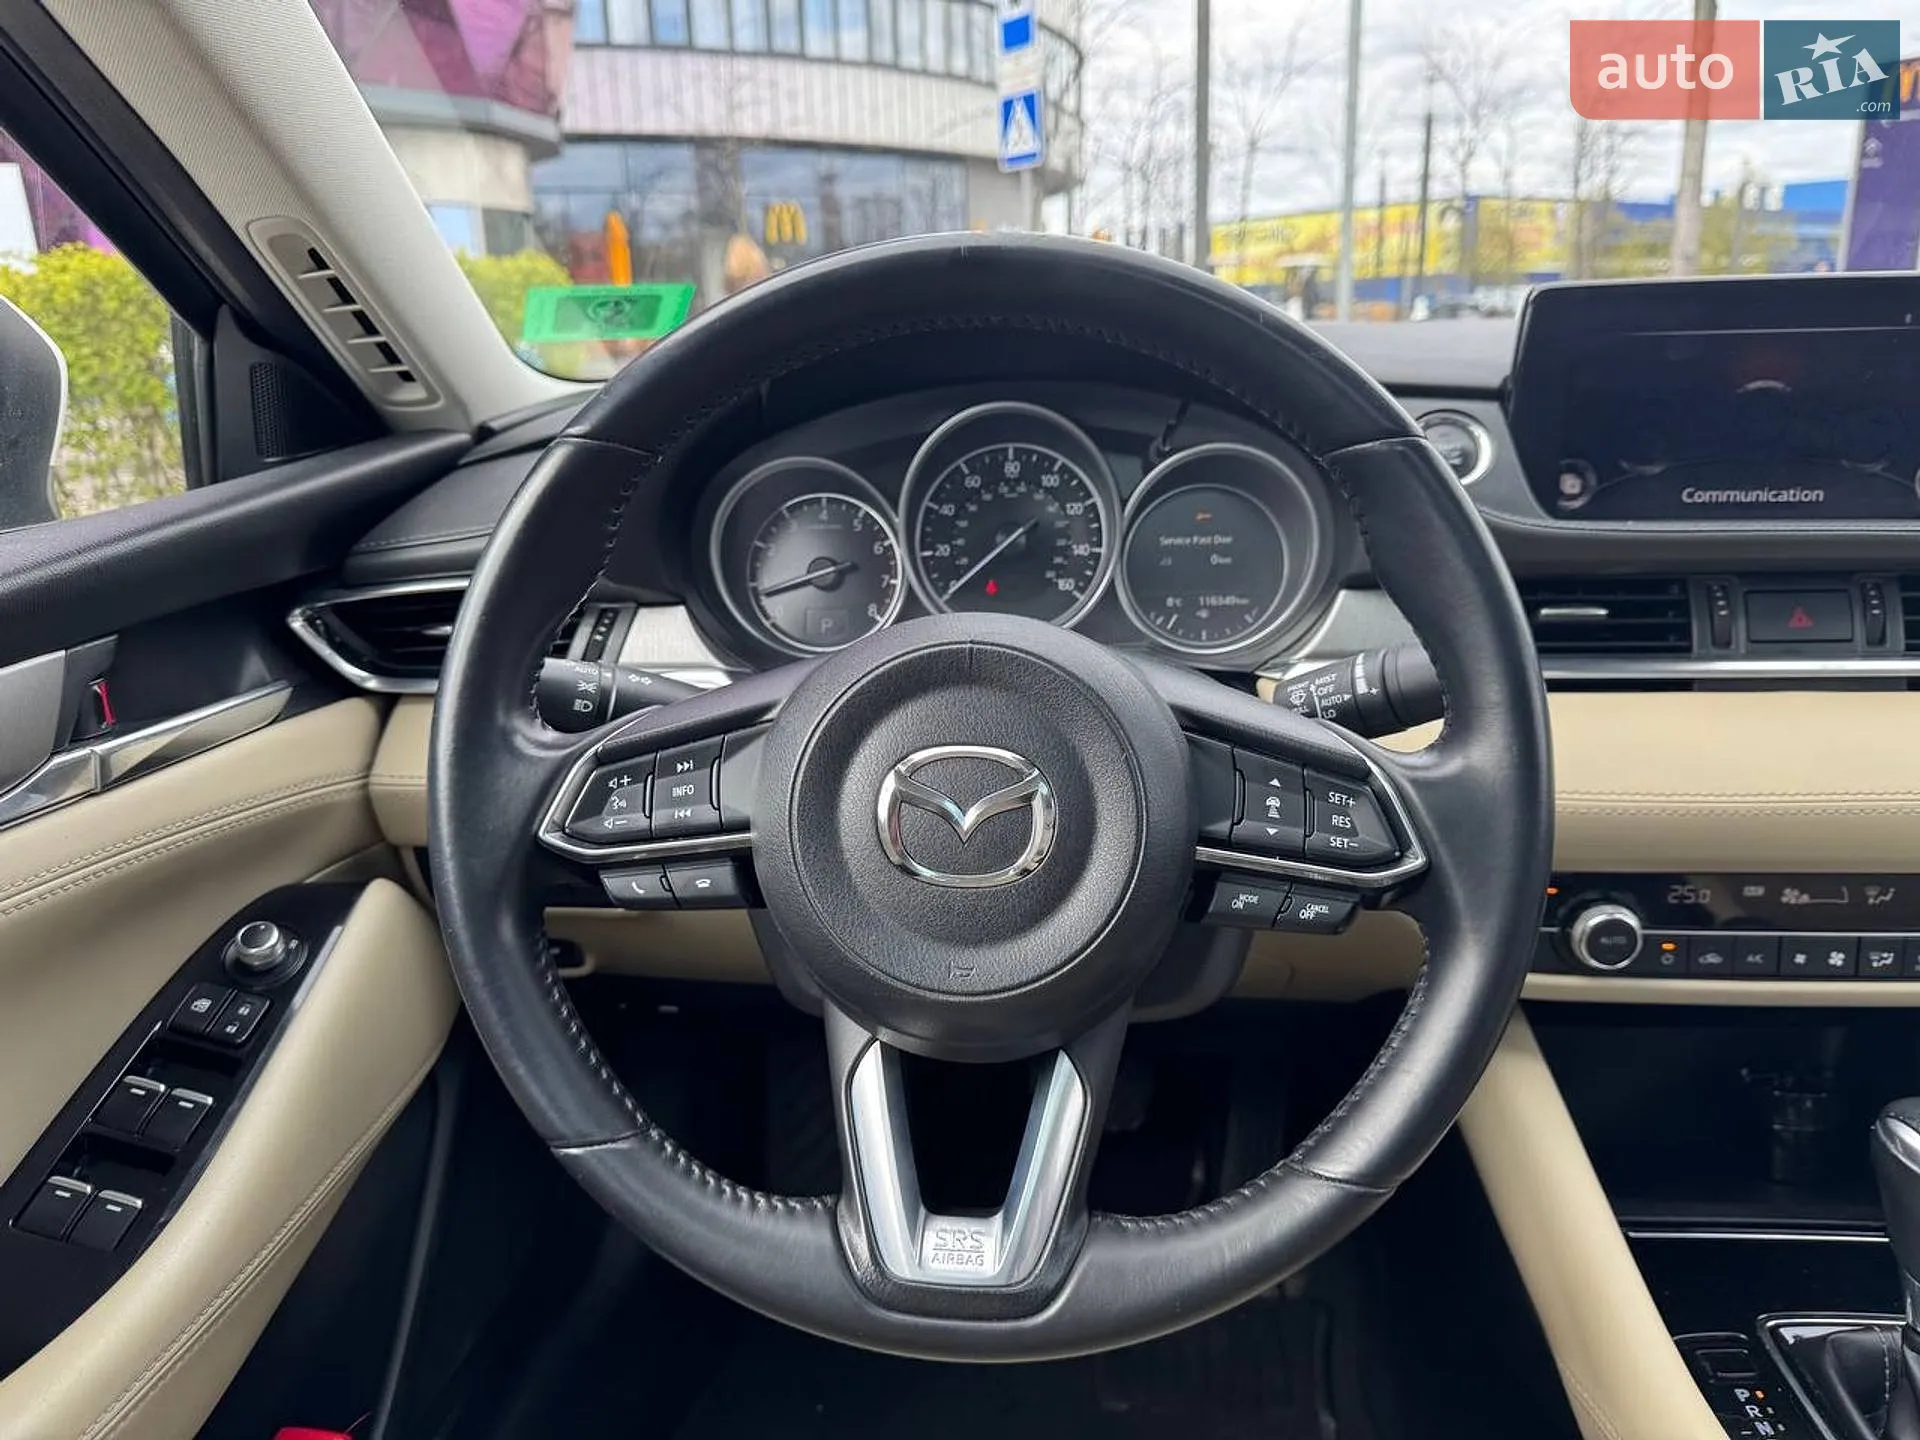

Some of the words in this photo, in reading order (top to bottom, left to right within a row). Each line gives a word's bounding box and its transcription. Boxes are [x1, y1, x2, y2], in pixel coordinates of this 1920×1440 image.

[1004, 461, 1021, 474] 80
[964, 476, 981, 488] 60
[1041, 474, 1059, 487] 100
[1681, 486, 1825, 503] Communication
[938, 504, 956, 516] 40
[1066, 502, 1083, 515] 120
[853, 519, 863, 531] 5
[1159, 535, 1191, 546] Service
[873, 545, 884, 555] 6
[934, 544, 950, 557] 20
[1072, 543, 1090, 556] 140
[880, 575, 890, 588] 7
[1057, 578, 1075, 591] 160
[867, 603, 878, 617] 8
[820, 617, 834, 634] P
[1317, 684, 1335, 696] OFF
[1320, 694, 1342, 707] AUTO
[1322, 709, 1337, 719] LO
[672, 784, 695, 797] INFO
[1328, 791, 1356, 807] SET+
[1331, 814, 1351, 828] RES
[1231, 899, 1244, 910] ON
[1299, 908, 1317, 920] OFF
[935, 1229, 985, 1249] SRS
[931, 1252, 984, 1266] AIRBAG
[1733, 1388, 1750, 1402] P
[1745, 1405, 1763, 1417] R
[1754, 1421, 1774, 1436] N
